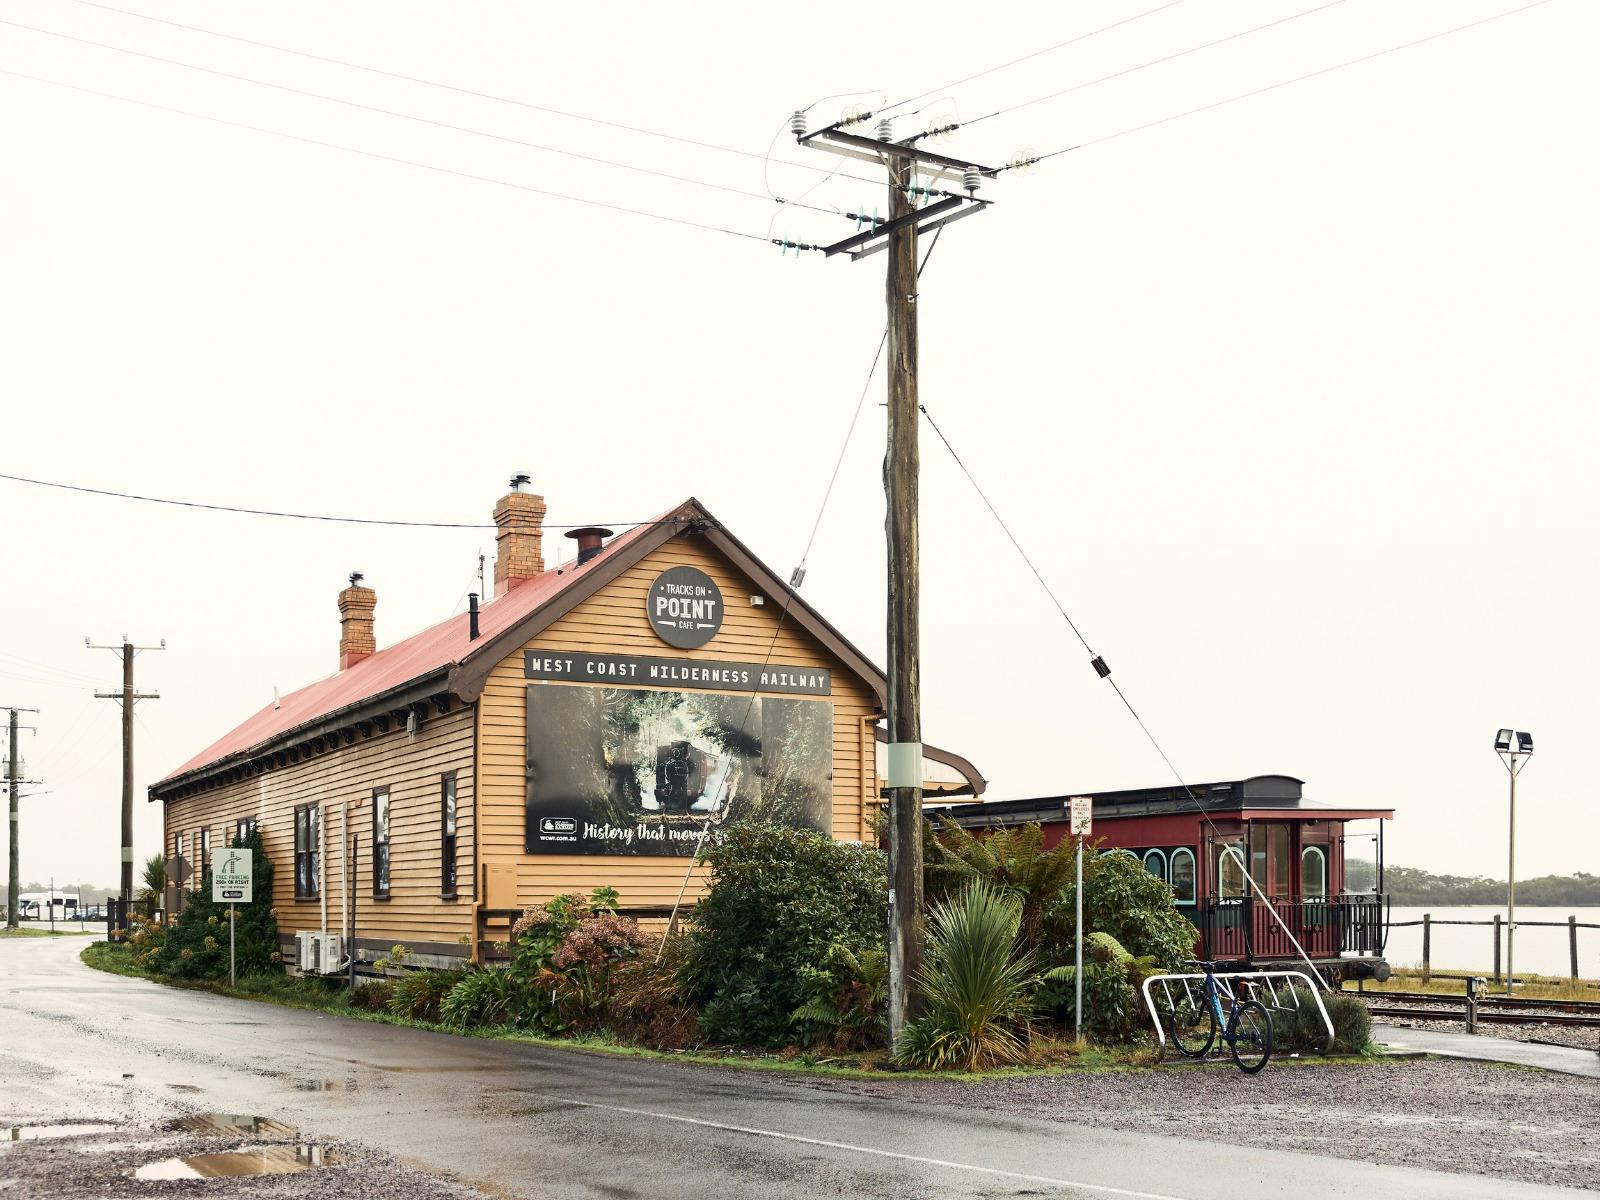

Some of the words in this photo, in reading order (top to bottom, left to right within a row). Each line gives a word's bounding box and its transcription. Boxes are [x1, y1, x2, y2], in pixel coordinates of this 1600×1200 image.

[666, 583, 694, 596] TRACKS
[695, 586, 706, 597] ON
[656, 596, 716, 620] POINT
[678, 620, 694, 630] CAFE
[532, 658, 573, 673] WEST
[586, 661, 637, 677] COAST
[650, 665, 749, 683] WILDERNESS
[760, 672, 825, 688] RAILWAY
[583, 821, 635, 846] History
[637, 823, 666, 841] that
